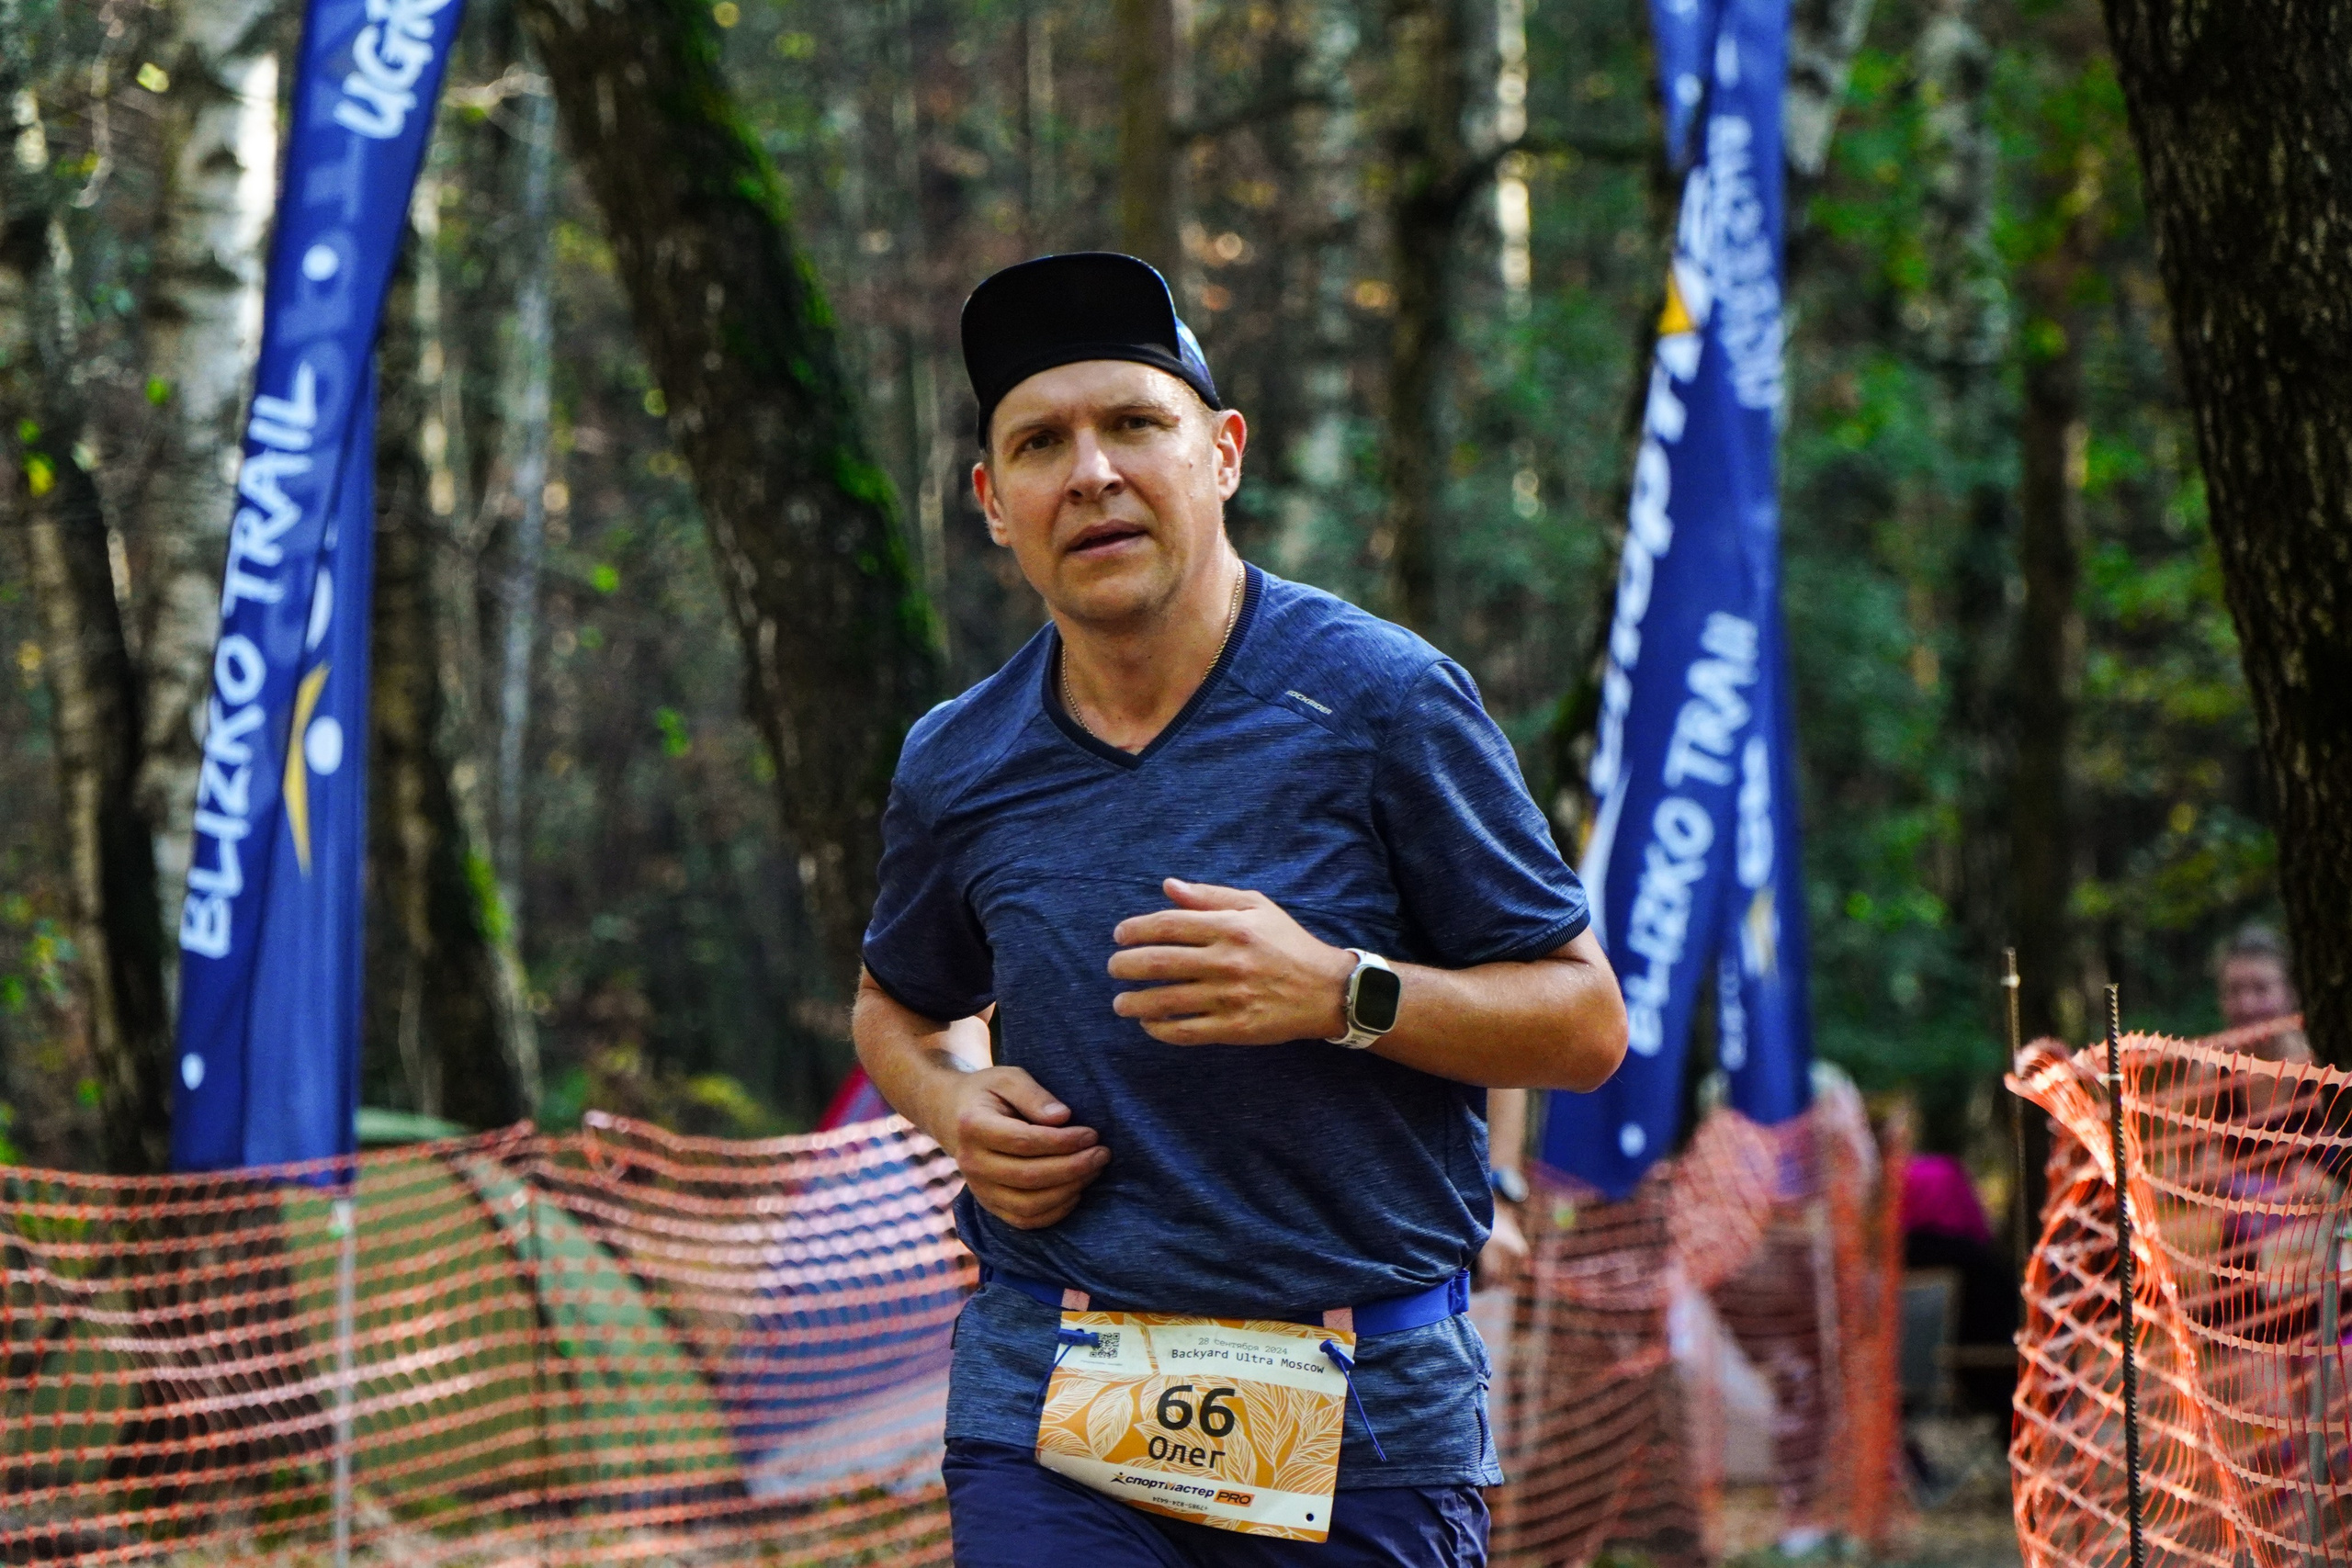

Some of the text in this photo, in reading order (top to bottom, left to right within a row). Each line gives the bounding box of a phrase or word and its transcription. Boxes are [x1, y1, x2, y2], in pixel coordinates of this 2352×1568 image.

[178, 360, 317, 959] BLIZKO TRAIL
[1198, 1337, 1210, 1346] 28
[1265, 1345, 1288, 1355] 2024
[1171, 1348, 1325, 1374] Backyard Ultra Moscow
[1156, 1384, 1236, 1438] 66
[1148, 1436, 1226, 1469] Олег
[1216, 1490, 1251, 1506] PRO
